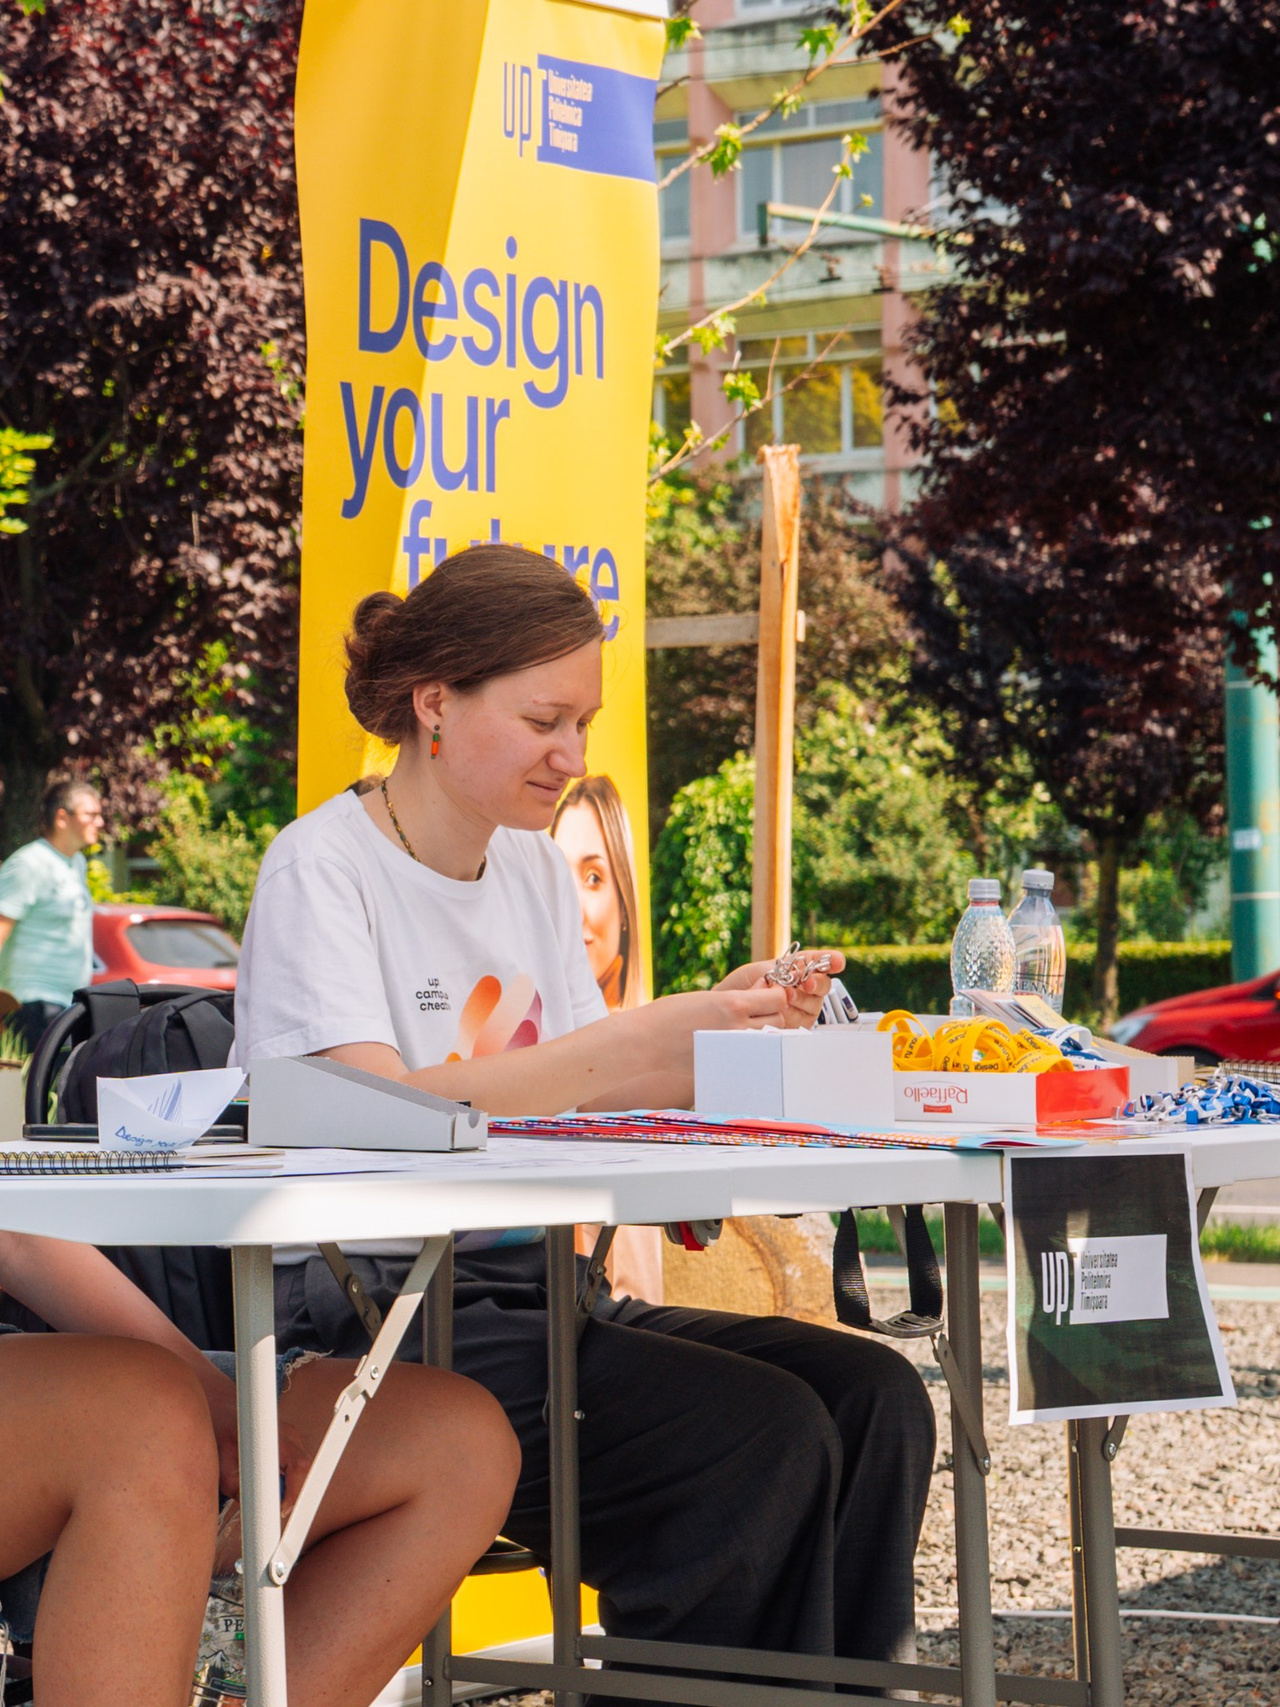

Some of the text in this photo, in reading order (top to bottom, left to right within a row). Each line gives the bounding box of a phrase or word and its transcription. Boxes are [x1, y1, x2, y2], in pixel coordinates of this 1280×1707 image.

[358, 217, 605, 409] Design
[339, 381, 511, 520] your
[903, 1085, 969, 1104] Raffaello
